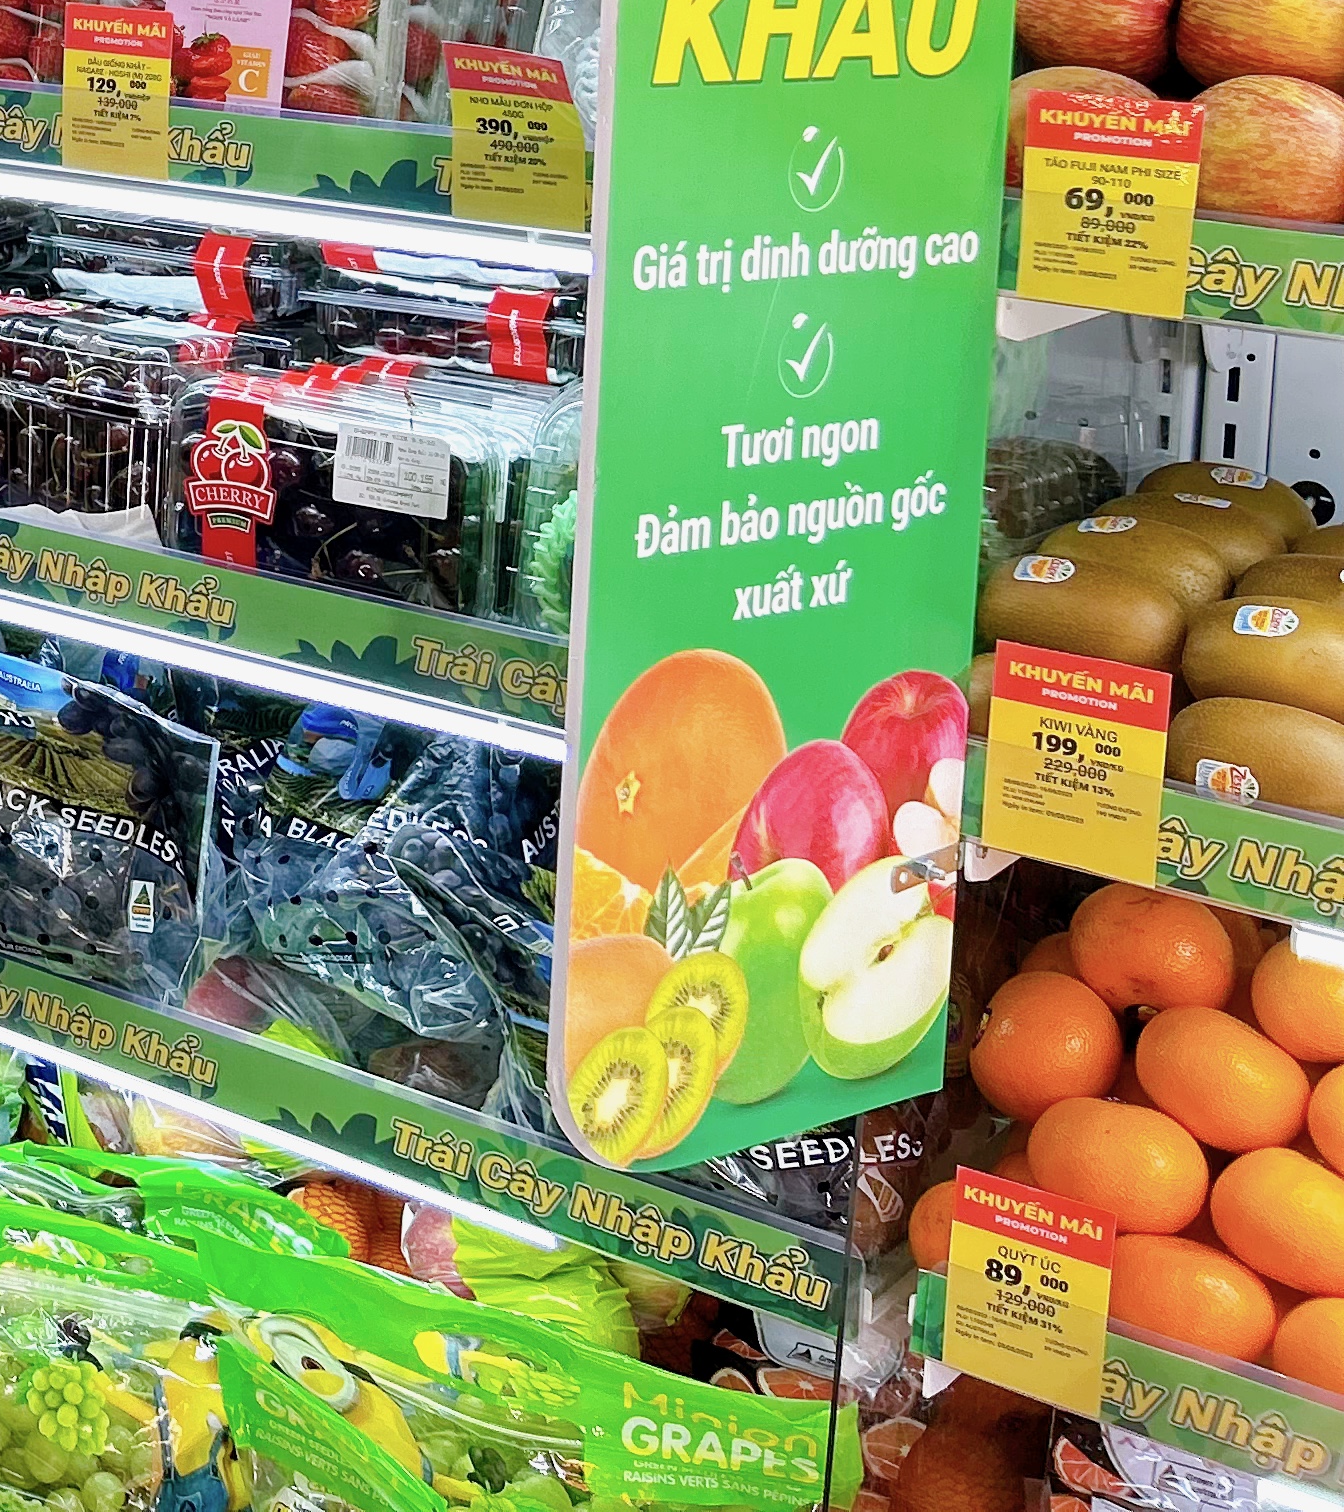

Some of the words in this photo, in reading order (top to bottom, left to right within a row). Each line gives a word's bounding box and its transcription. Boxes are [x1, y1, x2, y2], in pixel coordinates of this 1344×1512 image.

[73, 18, 135, 36] KHUYẾN
[137, 22, 166, 38] MÃI
[238, 69, 260, 93] C
[454, 57, 523, 77] KHUYẾN
[526, 67, 558, 83] MÃI
[476, 118, 518, 141] 390,
[1039, 108, 1137, 132] KHUYẾN
[1073, 132, 1153, 147] PROMOTION
[1065, 187, 1113, 218] 69,
[1124, 192, 1154, 206] 000
[632, 241, 688, 291] Giá
[696, 238, 733, 293] trị
[740, 232, 810, 281] dinh
[818, 227, 917, 279] dưỡng
[924, 229, 979, 266] cao
[721, 416, 793, 468] Tươi
[801, 417, 879, 467] ngon
[195, 487, 264, 509] CHERRY
[634, 504, 711, 558] Đảm
[720, 493, 779, 546] bảo
[788, 481, 884, 544] nguồn
[891, 470, 948, 531] gốc
[37, 547, 133, 605] Nhập
[138, 571, 237, 627] Khẩu
[732, 563, 802, 621] xuất
[809, 559, 853, 608] xứ
[411, 637, 495, 689] Trái
[1009, 660, 1103, 694] KHUYẾN
[1109, 681, 1154, 704] MÃI
[1042, 687, 1118, 711] PROMOTION
[1032, 731, 1085, 763] 199,
[1094, 743, 1121, 757] 000
[1039, 716, 1072, 734] KIWI
[1075, 722, 1118, 743] VÀNG
[22, 986, 116, 1054] Nhập
[120, 1019, 218, 1089] Khẩu
[390, 1117, 474, 1182] Trái
[477, 1149, 566, 1216] Cây
[569, 1181, 694, 1265] Nhập
[700, 1228, 831, 1312] Khẩu
[963, 1185, 1054, 1226] KHUYẾN
[1059, 1218, 1103, 1241] MÃI
[994, 1215, 1068, 1245] PROMOTION
[985, 1258, 1031, 1296] 89,
[1040, 1274, 1069, 1293] 000
[998, 1245, 1037, 1266] QUÝT
[1040, 1255, 1062, 1274] ÚC
[621, 1415, 820, 1483] GRAPES
[1172, 1389, 1329, 1479] Nhập
